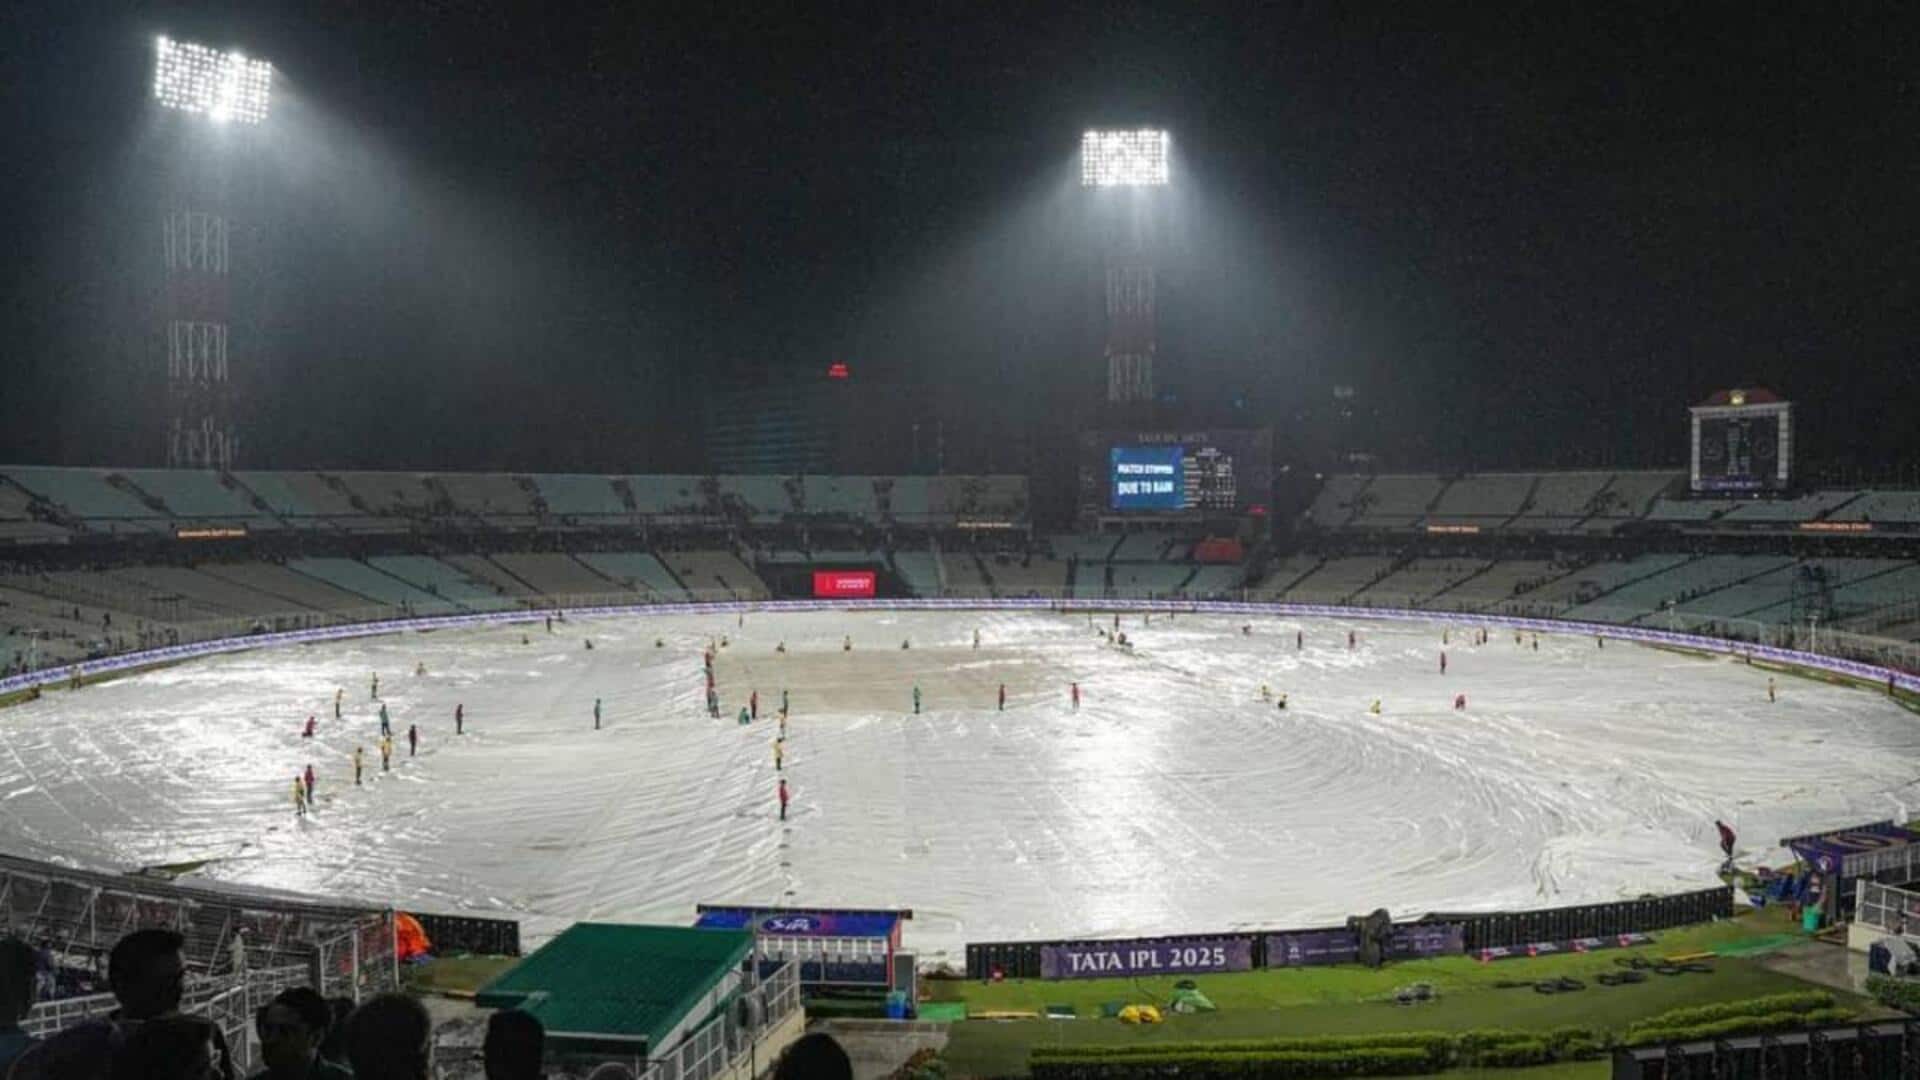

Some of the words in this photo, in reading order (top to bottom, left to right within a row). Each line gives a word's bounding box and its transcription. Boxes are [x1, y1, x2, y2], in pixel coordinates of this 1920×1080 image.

[1068, 950, 1123, 971] TATA
[1129, 949, 1162, 968] IPL
[1169, 947, 1226, 966] 2025
